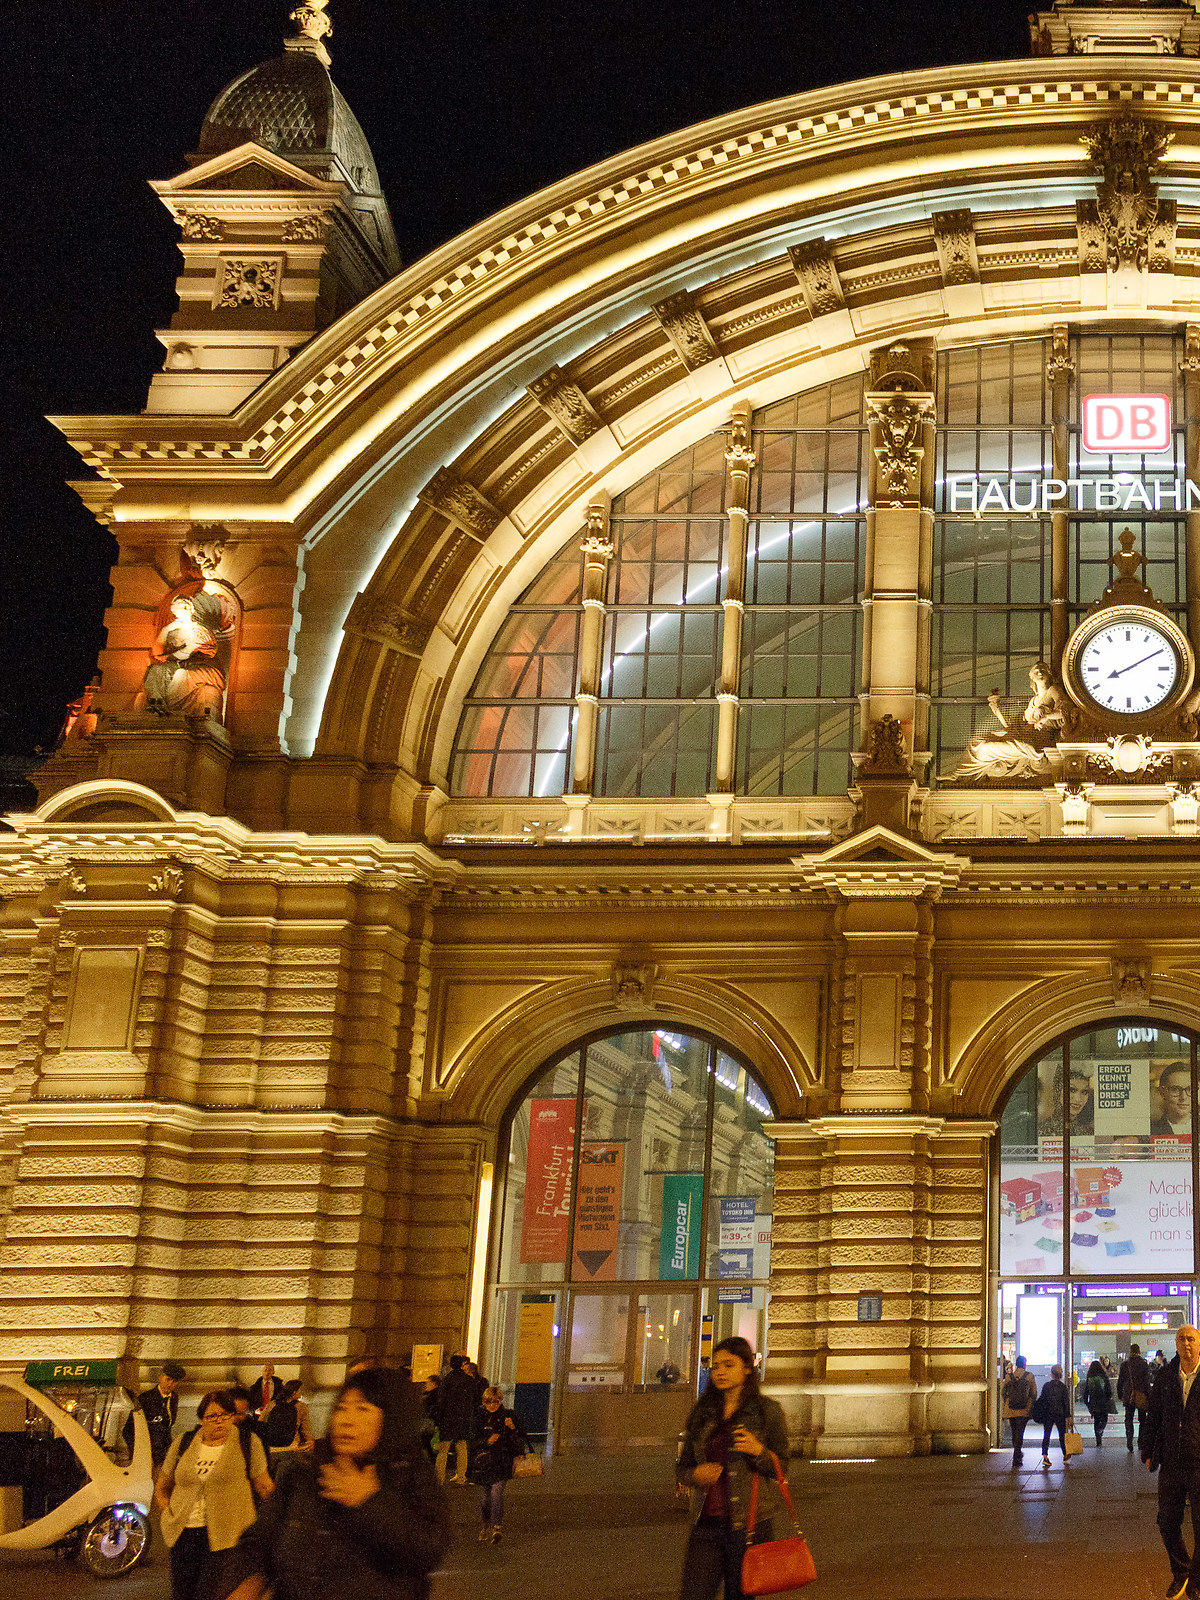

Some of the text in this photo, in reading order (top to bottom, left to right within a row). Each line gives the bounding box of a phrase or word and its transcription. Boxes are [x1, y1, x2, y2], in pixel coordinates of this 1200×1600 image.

[1095, 405, 1157, 440] DB
[1099, 1066, 1130, 1074] ERFOLG
[536, 1145, 564, 1215] Frankfurt
[671, 1200, 689, 1269] Europcar
[1150, 1230, 1180, 1240] man
[53, 1365, 90, 1376] FREI
